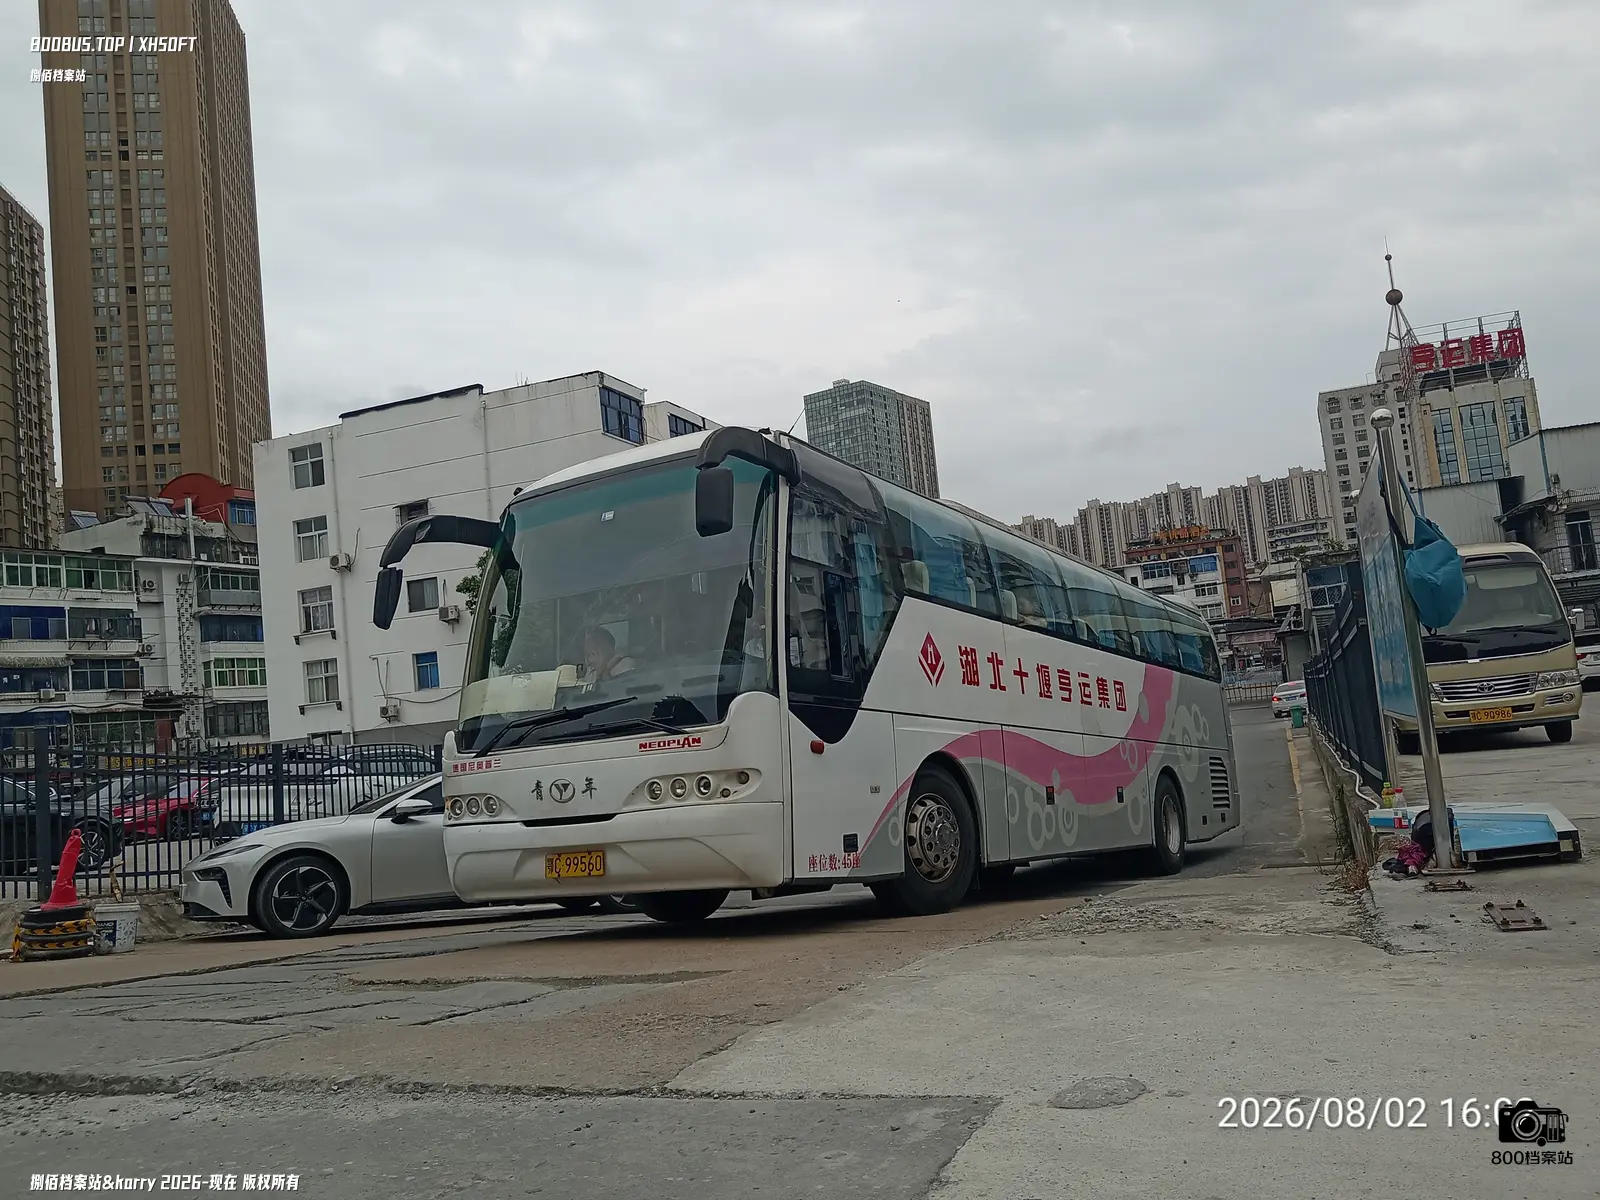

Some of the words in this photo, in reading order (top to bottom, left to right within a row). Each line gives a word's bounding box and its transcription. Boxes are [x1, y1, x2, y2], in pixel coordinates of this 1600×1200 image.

[957, 644, 1128, 712] 湖北十堰亨运集团
[639, 736, 702, 752] NEOPLAN
